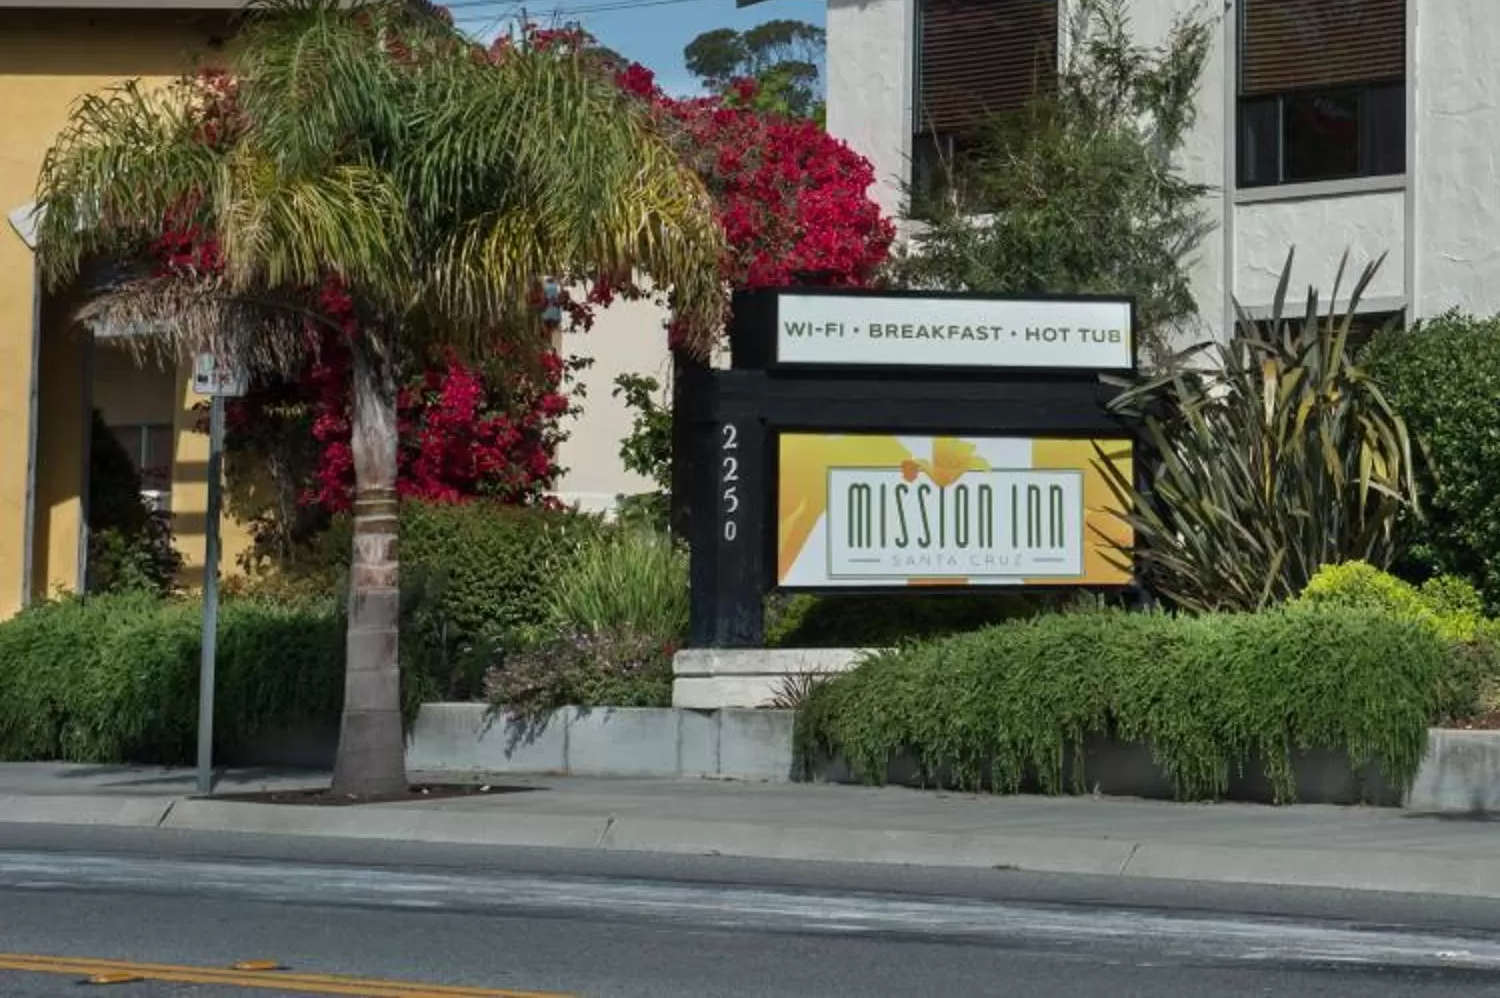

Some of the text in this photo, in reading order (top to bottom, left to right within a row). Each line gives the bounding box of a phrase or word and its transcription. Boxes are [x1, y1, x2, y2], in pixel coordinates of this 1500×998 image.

[784, 321, 1121, 343] WI-FI BREAKFAST HOT TUB
[722, 425, 739, 541] 2250
[847, 482, 1065, 549] MISSION INN
[891, 554, 1022, 567] SANTA CRUZ
